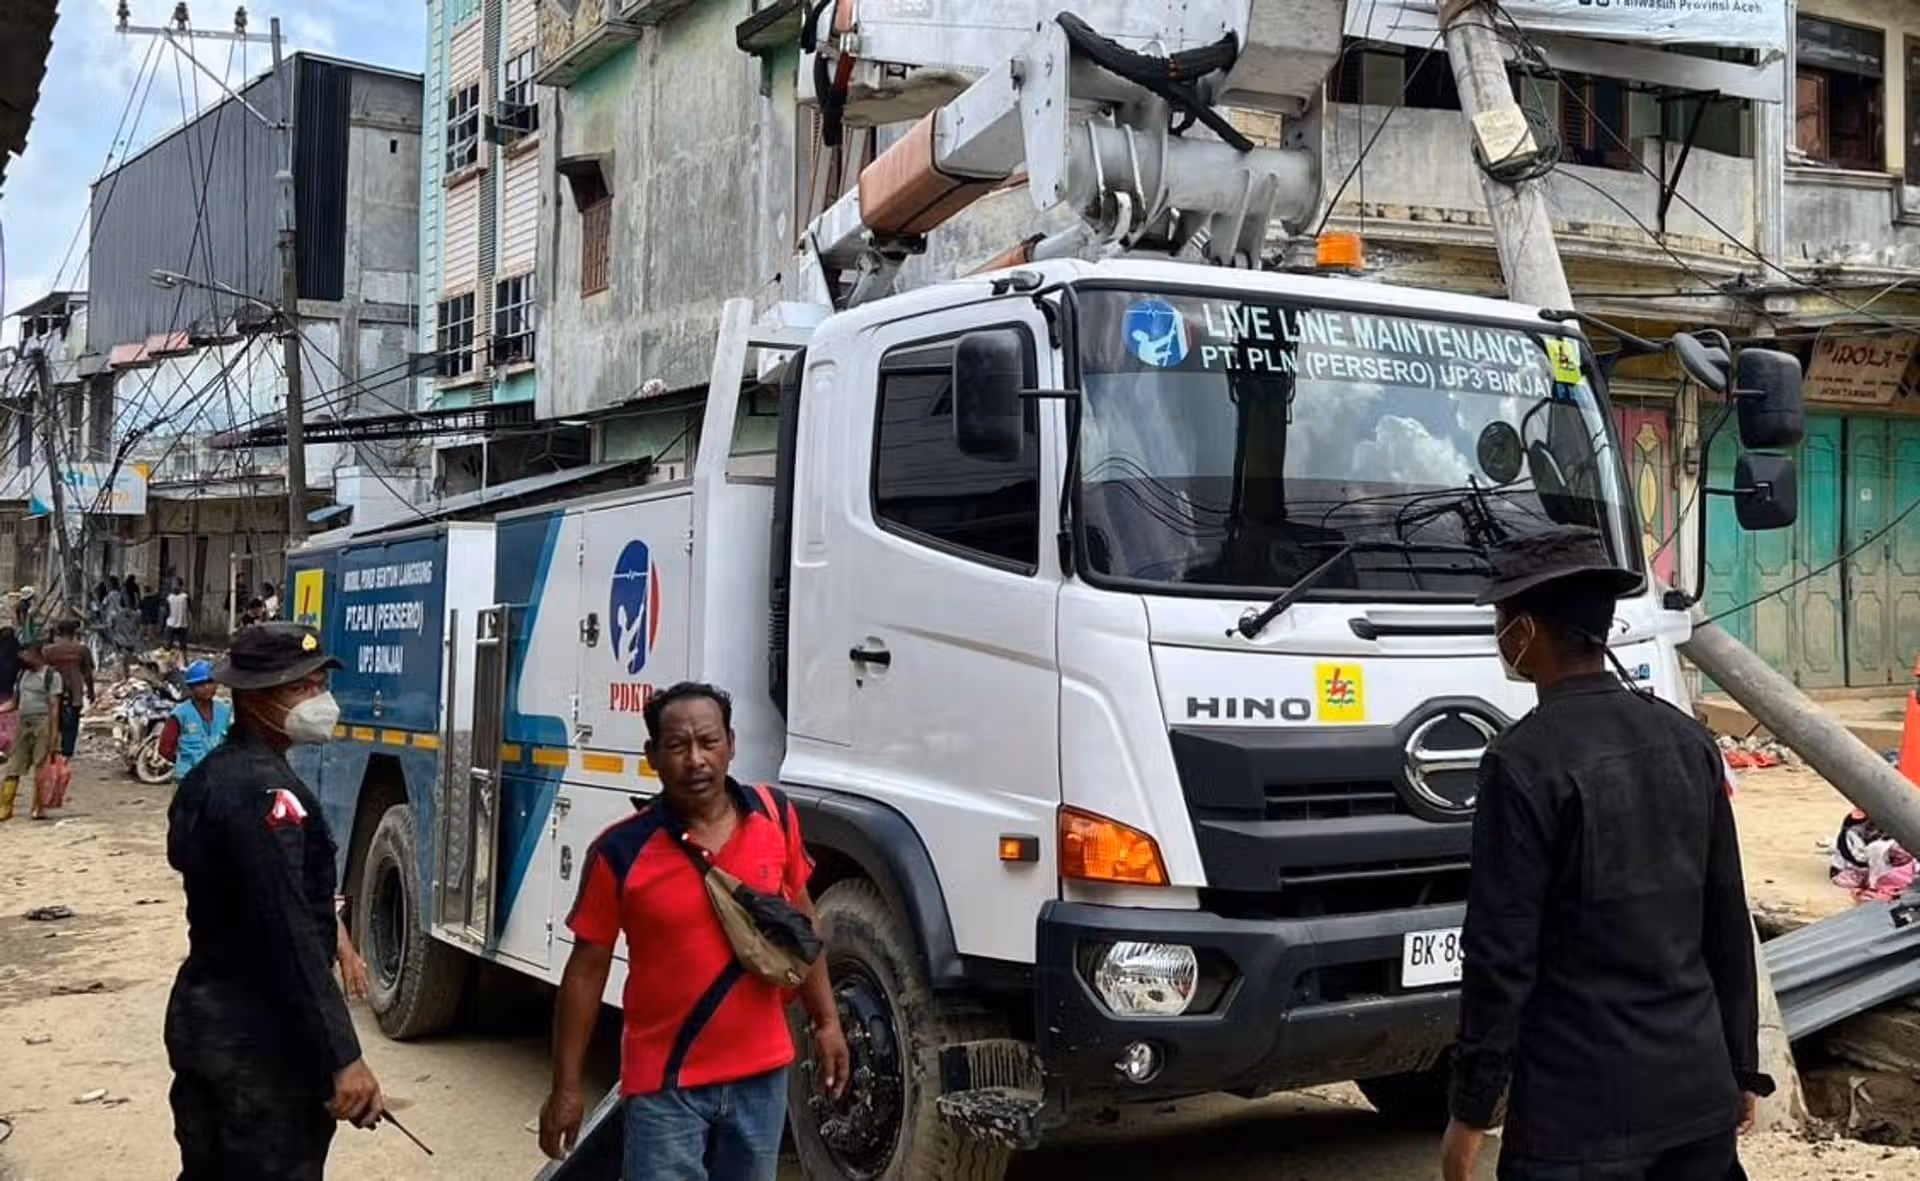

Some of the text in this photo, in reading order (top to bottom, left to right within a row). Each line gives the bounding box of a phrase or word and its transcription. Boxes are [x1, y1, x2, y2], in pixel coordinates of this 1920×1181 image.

[1680, 0, 1729, 11] Provinsi
[1733, 2, 1762, 13] Aceh
[1202, 303, 1541, 369] LIVE LINE MAINTENANCE
[1201, 345, 1241, 370] PT.
[1247, 347, 1299, 373] PLN
[1305, 351, 1436, 391] (PERSERO)
[1440, 364, 1484, 390] UP3
[374, 601, 424, 638] (PERSERO)
[375, 645, 404, 674] BINJAI
[1187, 696, 1312, 721] HINO
[1411, 934, 1436, 966] BK
